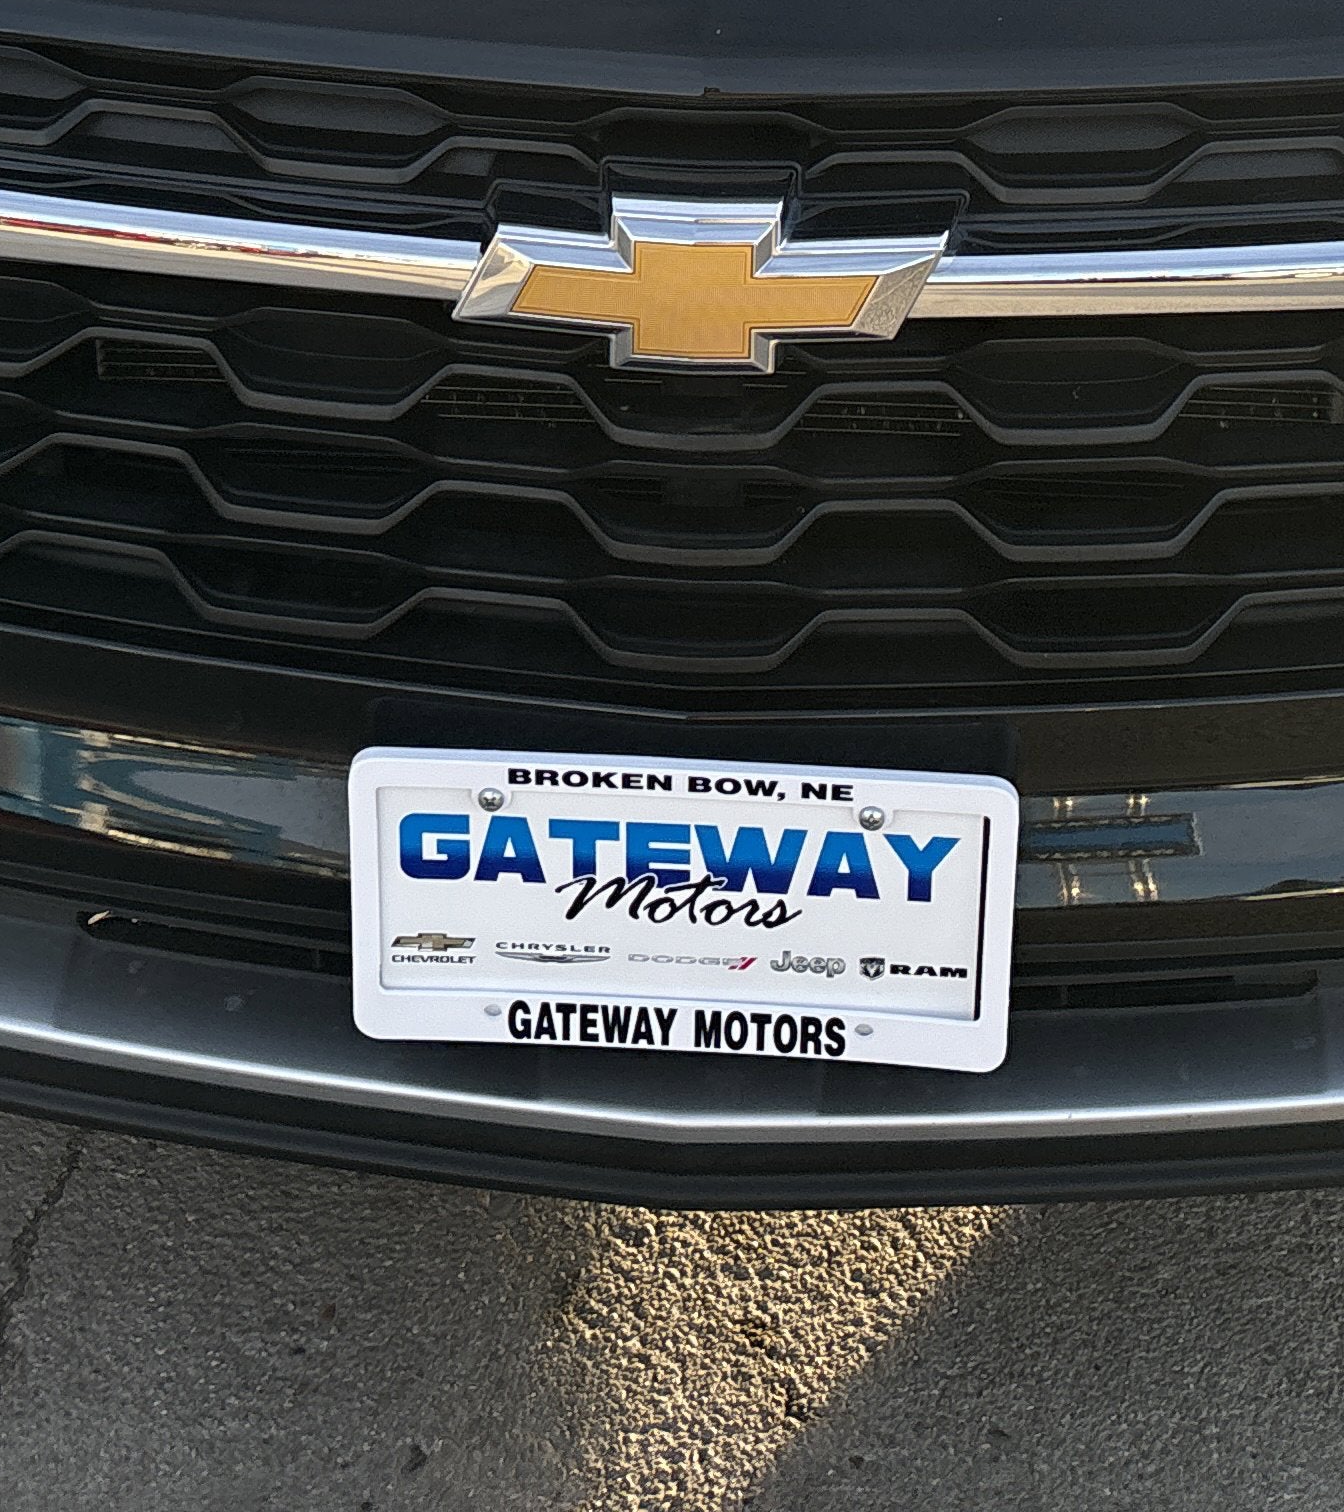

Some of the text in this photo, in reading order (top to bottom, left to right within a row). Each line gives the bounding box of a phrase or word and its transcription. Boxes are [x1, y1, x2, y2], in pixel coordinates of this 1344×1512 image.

[507, 767, 855, 802] BROKEN BOW, NE
[398, 812, 962, 903] GATEWAY
[554, 873, 803, 929] Motors
[391, 954, 477, 965] CHEVROLET
[495, 941, 612, 954] CHRYSLER
[627, 953, 741, 967] DODGE
[769, 950, 847, 978] Jeep
[888, 964, 969, 979] RAM
[507, 999, 847, 1057] GATEWAY MOTORS
